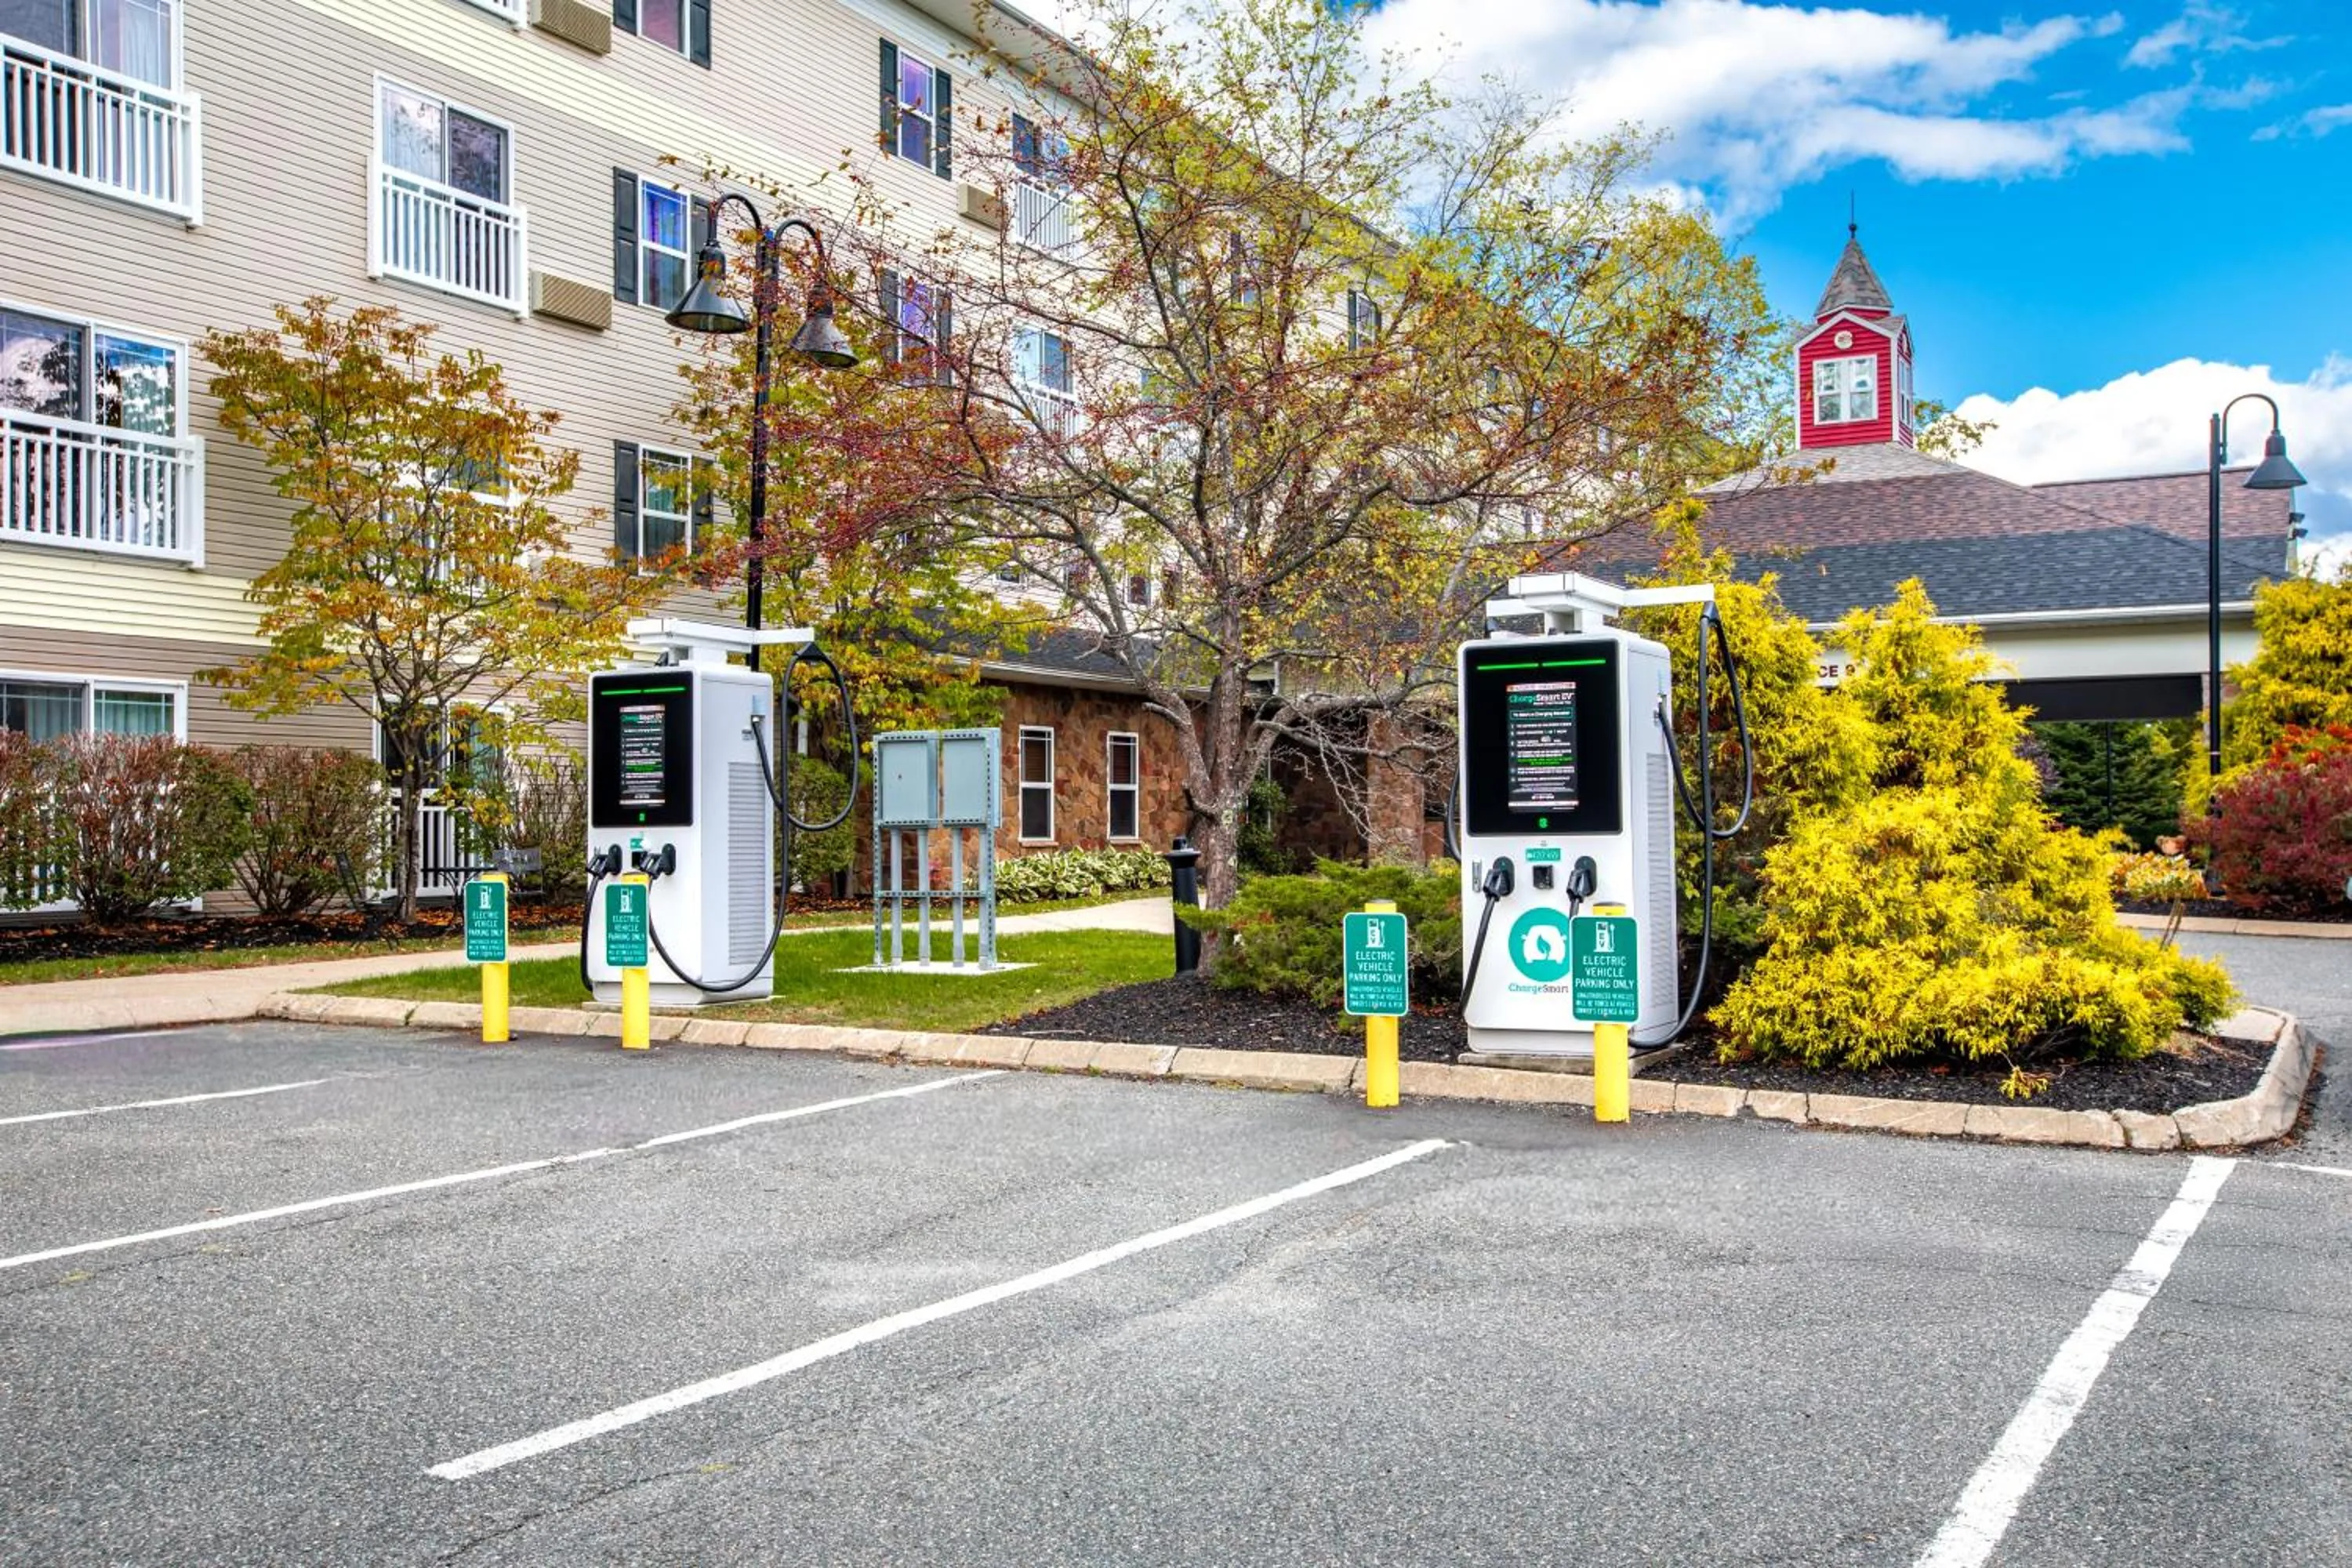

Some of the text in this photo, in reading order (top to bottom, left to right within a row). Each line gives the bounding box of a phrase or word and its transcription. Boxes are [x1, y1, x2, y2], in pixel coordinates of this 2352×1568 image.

[1356, 951, 1395, 961] ELECTRIC
[1583, 956, 1627, 966] ELECTRIC
[1357, 962, 1393, 971] VEHICLE
[1584, 967, 1624, 977] VEHICLE
[1348, 973, 1403, 983] PARKING ONLY
[1575, 978, 1635, 989] PARKING ONLY
